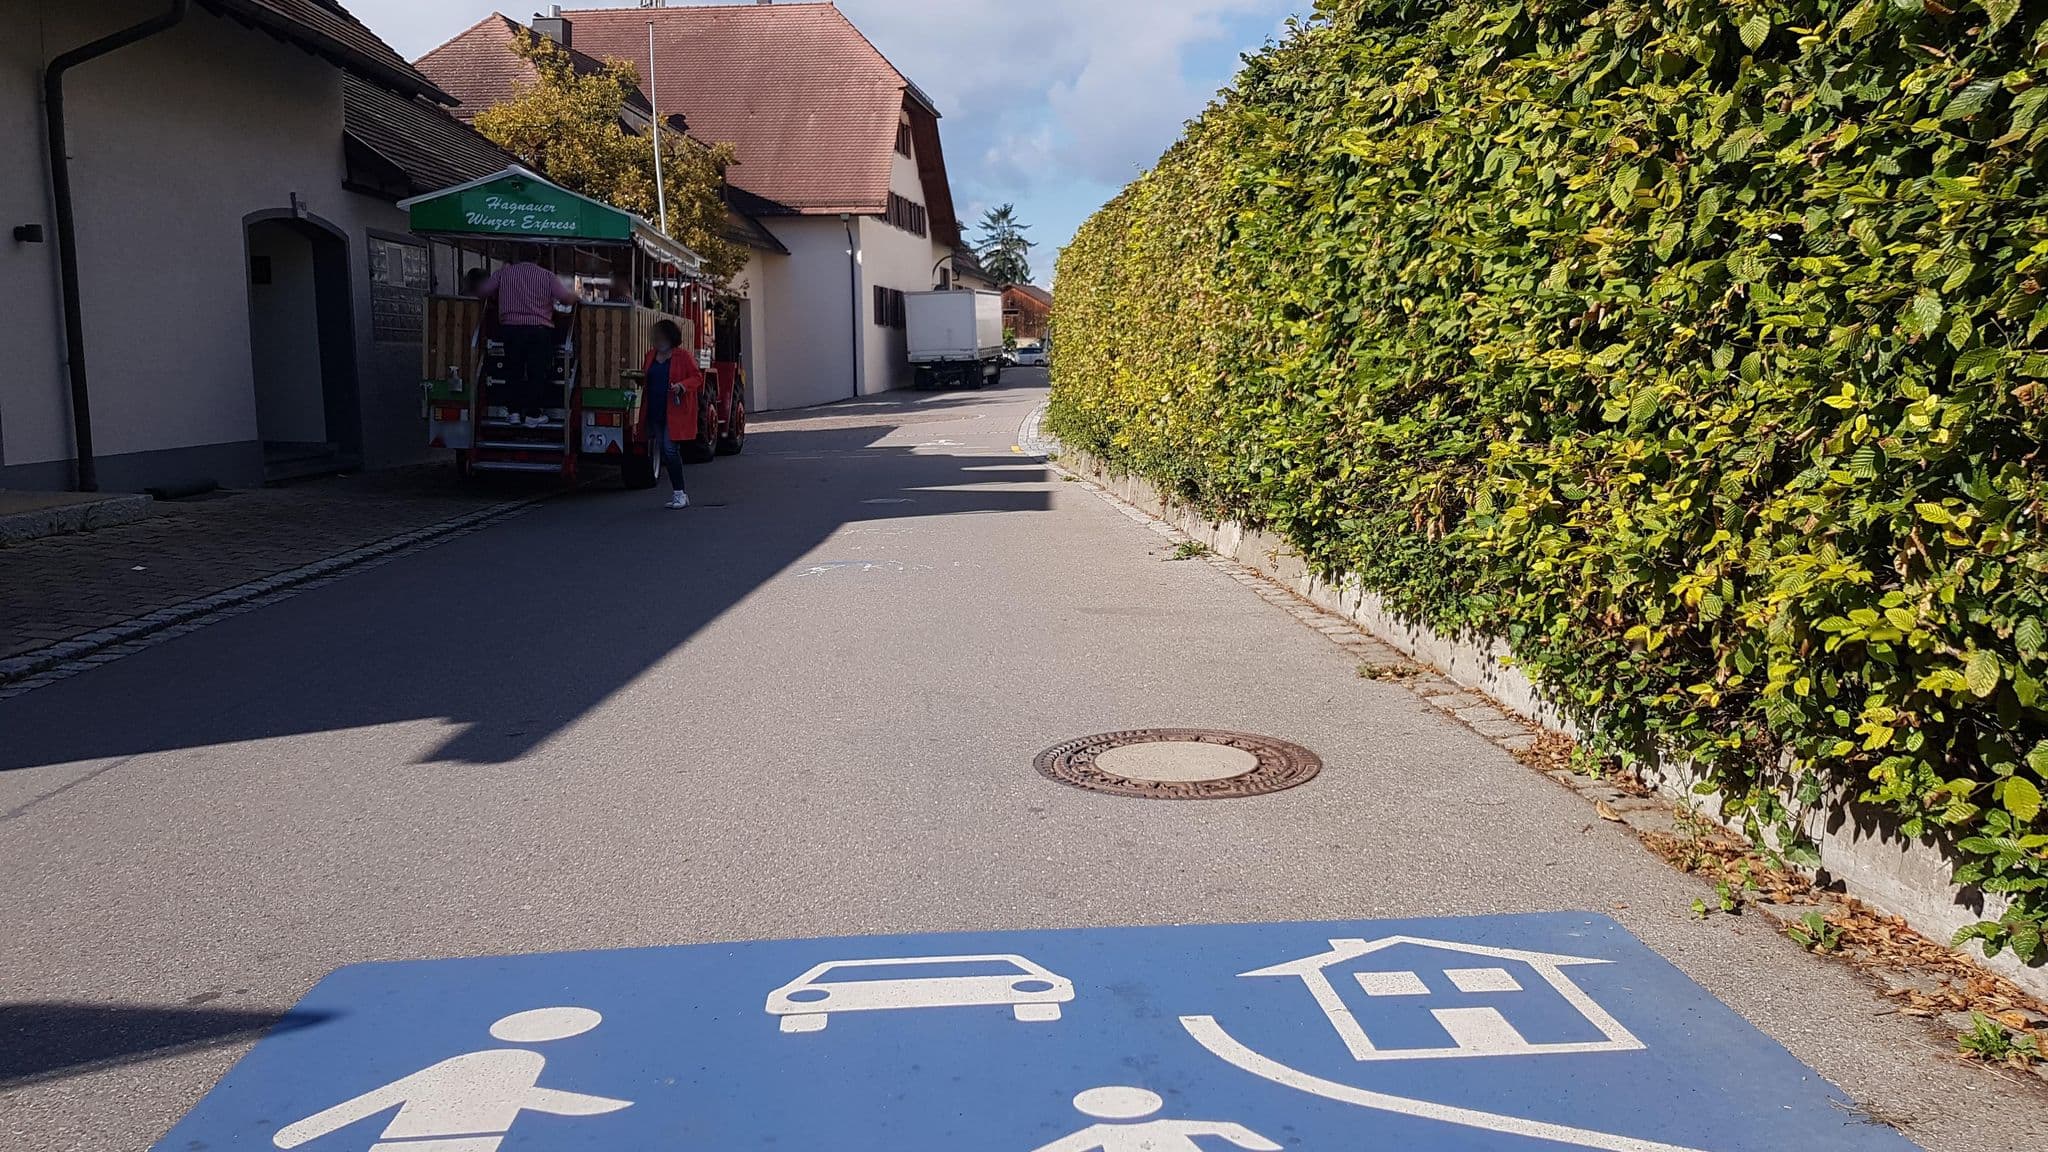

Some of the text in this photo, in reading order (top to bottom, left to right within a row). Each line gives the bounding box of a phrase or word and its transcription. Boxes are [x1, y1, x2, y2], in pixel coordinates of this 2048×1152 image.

[485, 196, 557, 214] Hagnauer
[465, 212, 577, 231] Winzer Express
[589, 433, 603, 447] 25
